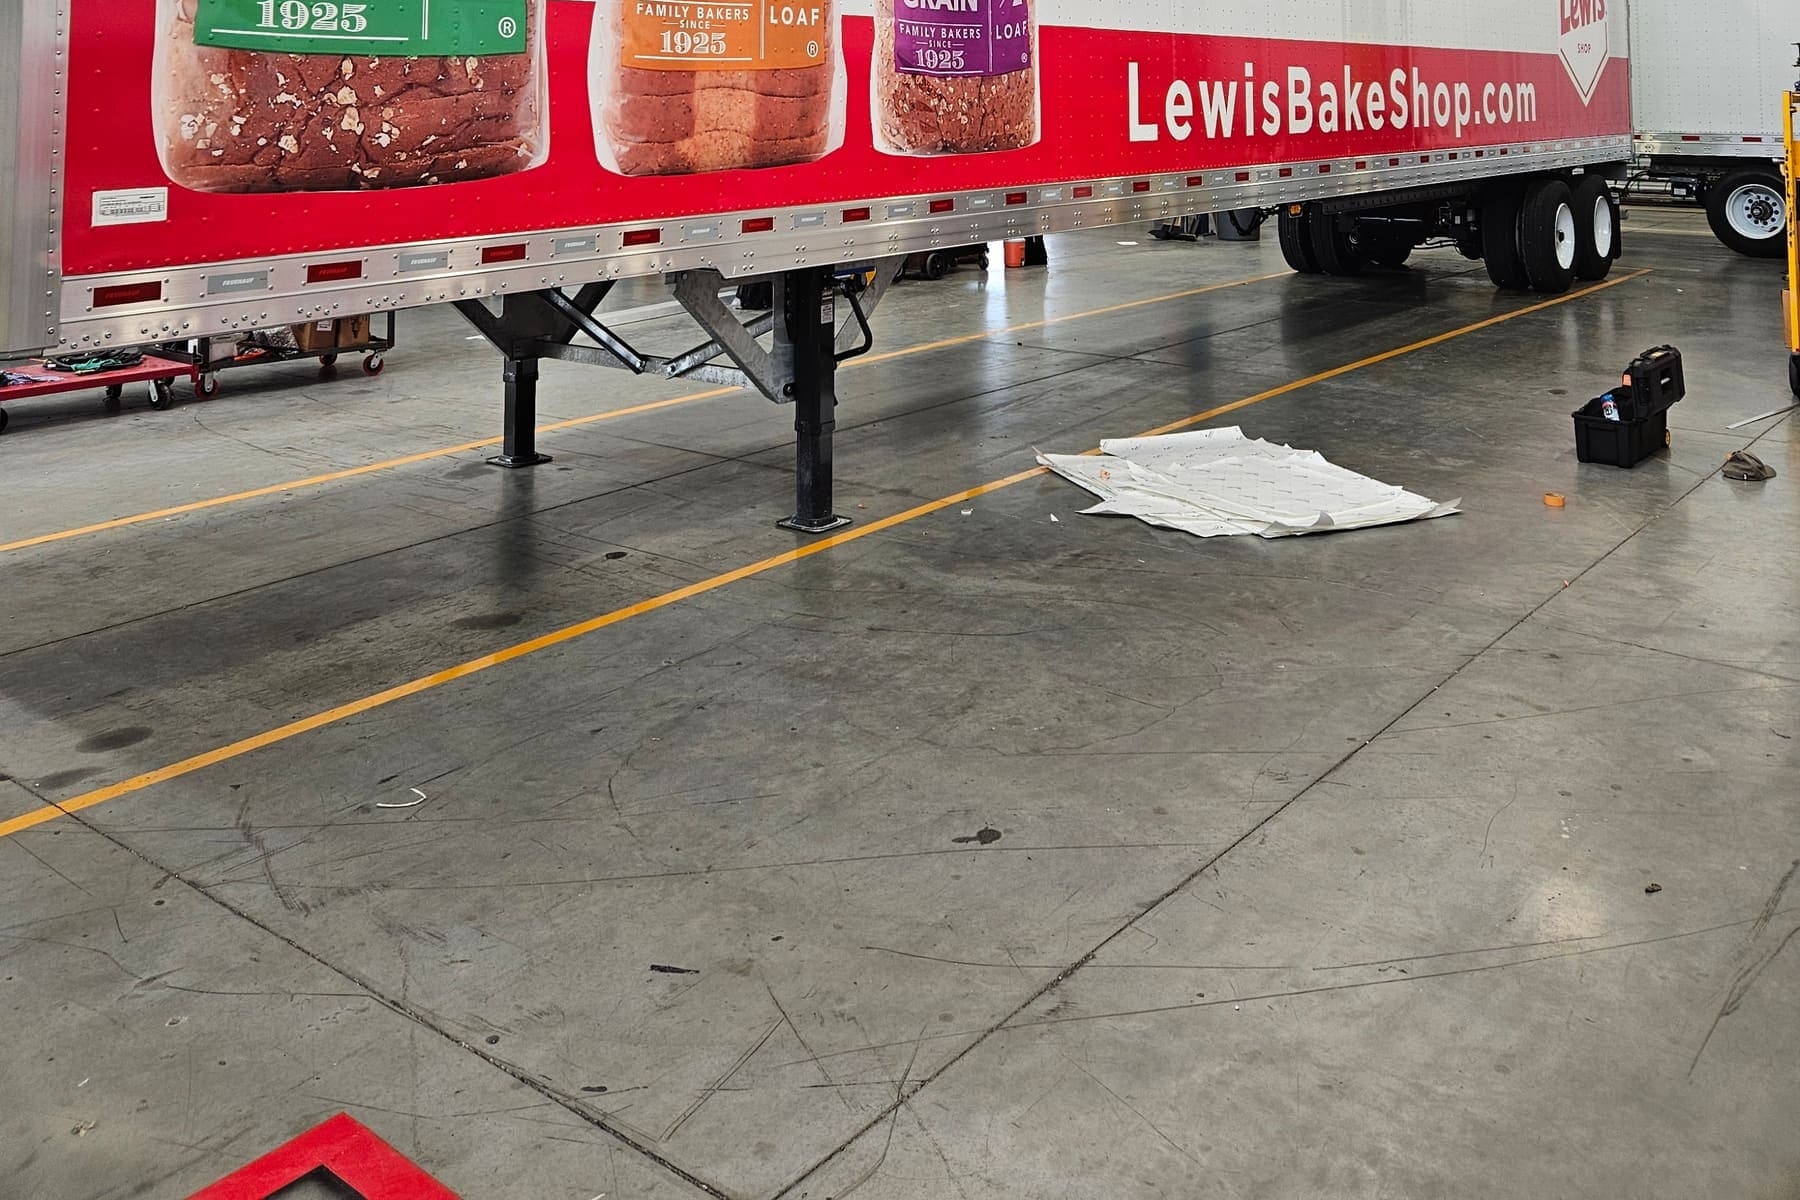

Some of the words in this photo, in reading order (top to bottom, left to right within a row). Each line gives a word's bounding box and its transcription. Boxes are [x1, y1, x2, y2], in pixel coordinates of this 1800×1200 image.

[636, 3, 689, 18] FAMILY
[697, 7, 749, 21] BAKERS
[769, 5, 820, 26] LOAF
[679, 19, 711, 30] SINCE
[900, 23, 936, 38] FAMILY
[941, 28, 981, 39] BAKERS
[995, 20, 1027, 40] LOAF
[659, 30, 726, 55] 1925
[928, 39, 951, 48] SINCE
[915, 48, 964, 70] 1925
[1128, 62, 1537, 142] LewisBakeShop.com
